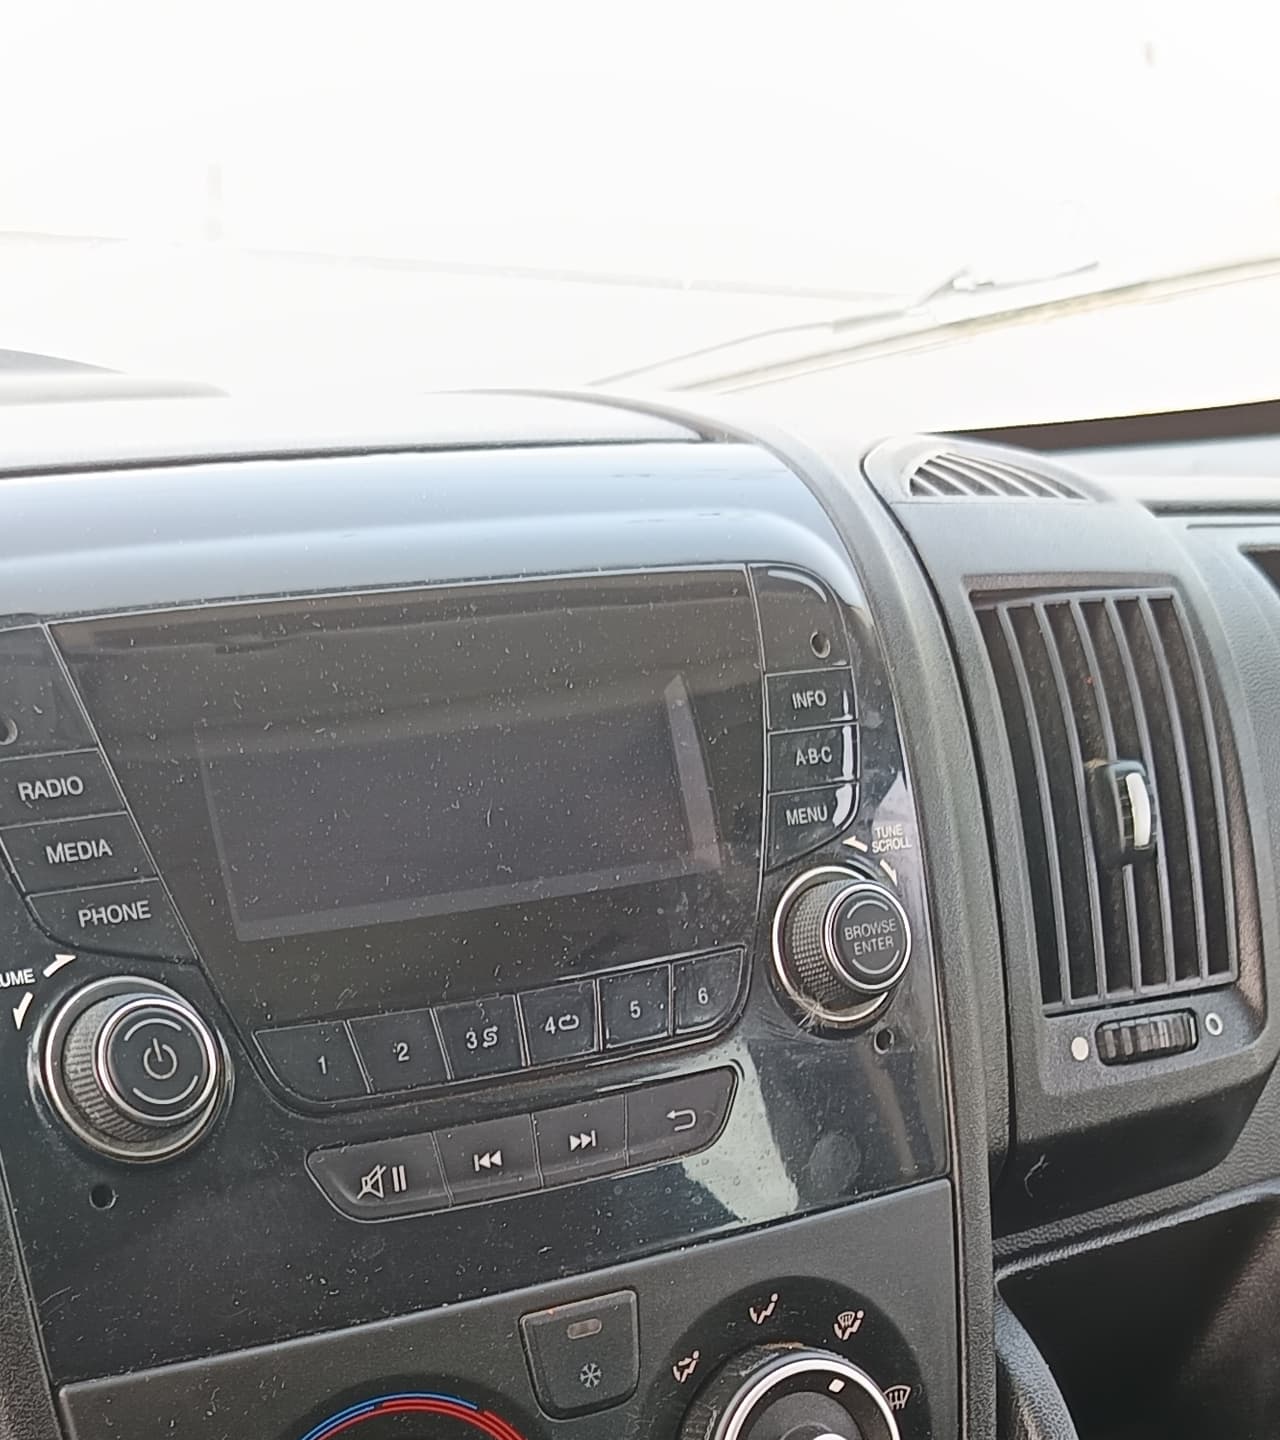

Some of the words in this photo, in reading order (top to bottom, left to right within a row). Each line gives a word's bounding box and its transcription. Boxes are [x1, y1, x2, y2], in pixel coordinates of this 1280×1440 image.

[792, 690, 827, 709] INFO
[18, 776, 83, 801] RADIO
[786, 805, 828, 826] MENU
[875, 826, 903, 838] TUNE
[46, 839, 112, 864] MEDIA
[871, 836, 911, 853] SCROLL
[77, 901, 151, 928] PHONE
[844, 919, 897, 941] BROWSE
[853, 937, 894, 955] ENTER
[319, 1056, 328, 1074] 1
[396, 1042, 410, 1061] 2
[466, 1031, 478, 1049] 3
[544, 1016, 557, 1034] 4
[630, 1001, 641, 1019] 5
[696, 986, 707, 1004] 6
